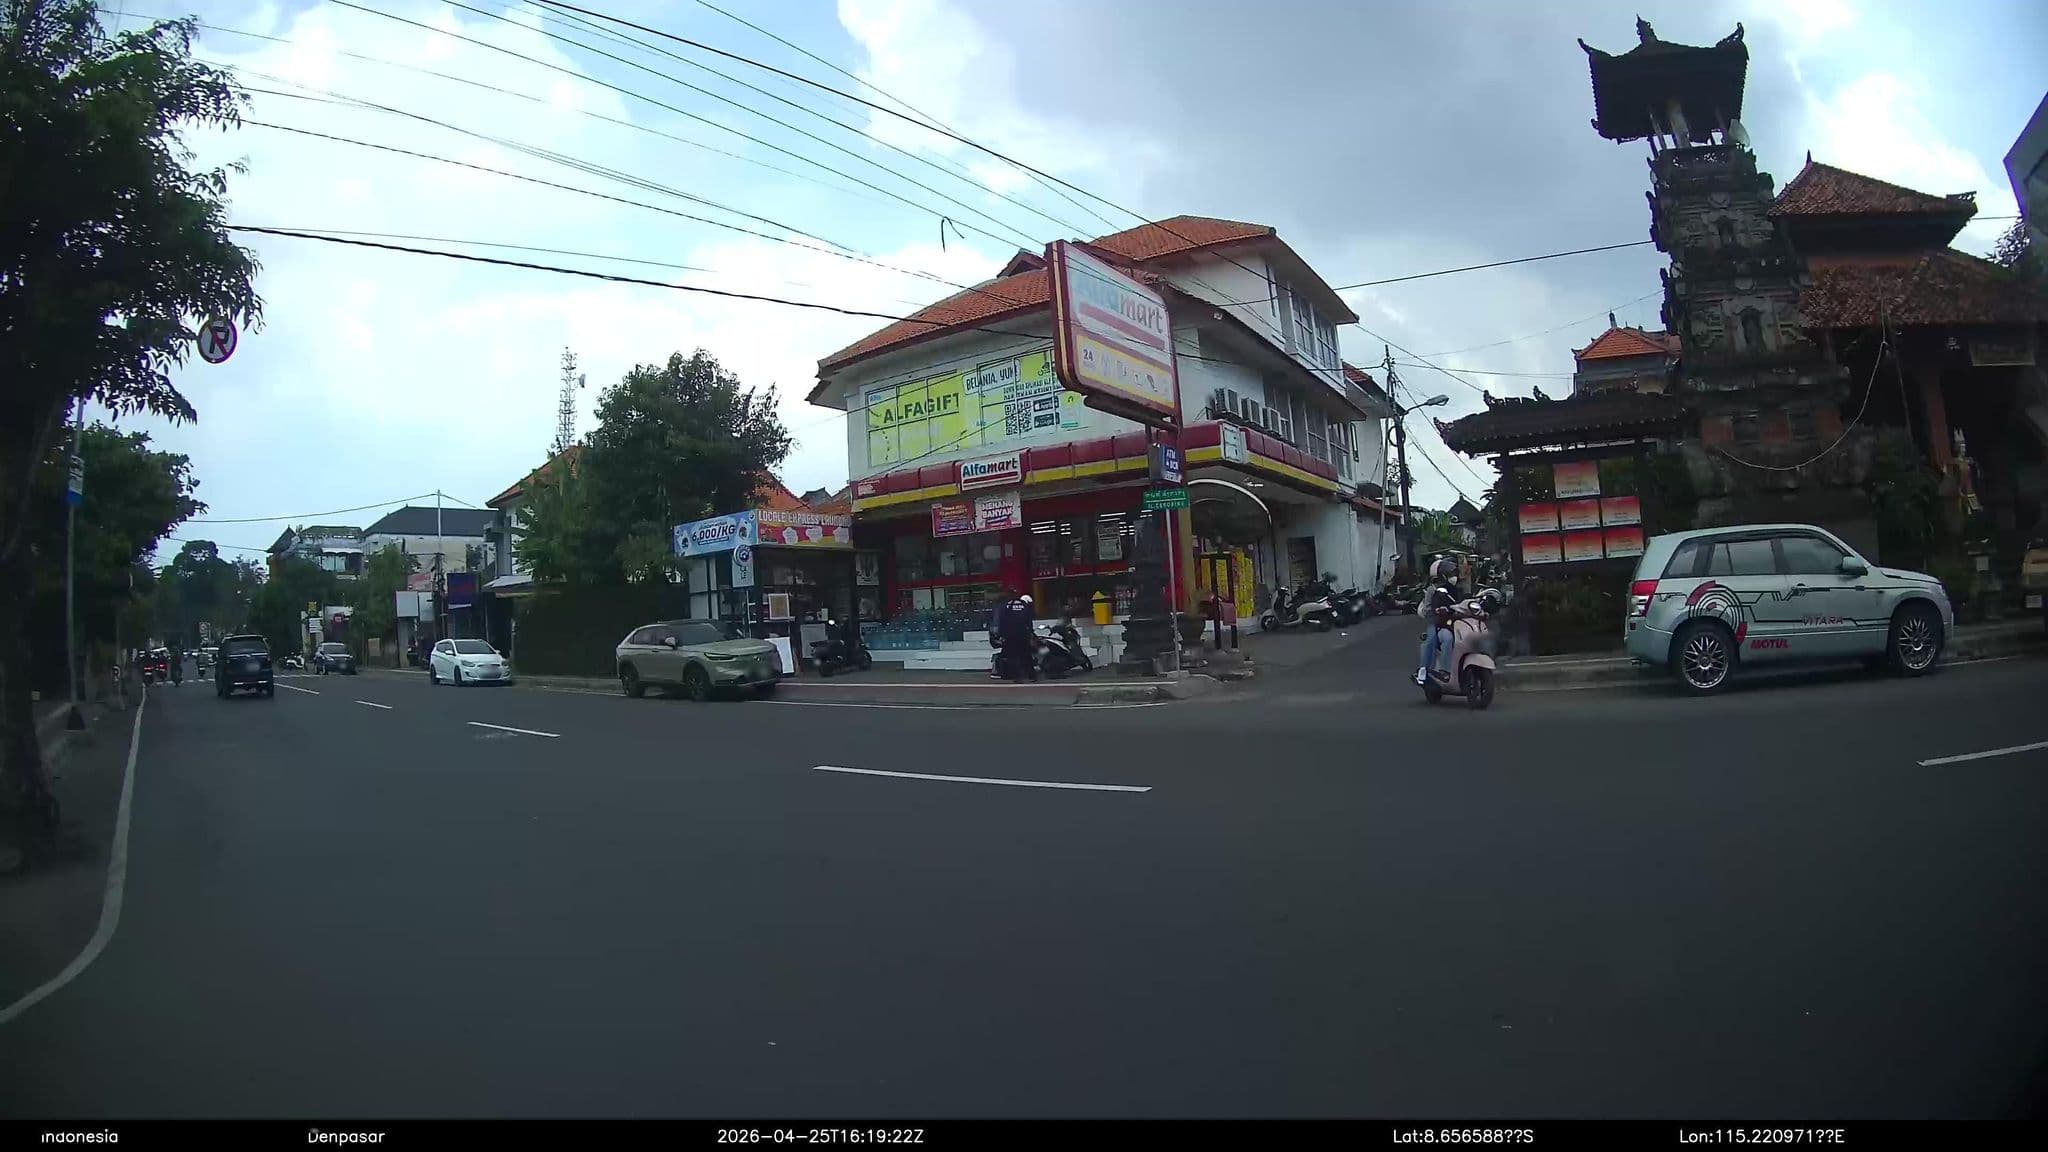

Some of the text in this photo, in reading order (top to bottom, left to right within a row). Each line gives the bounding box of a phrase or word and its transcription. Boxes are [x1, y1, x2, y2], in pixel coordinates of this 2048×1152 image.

[883, 392, 960, 424] ALFAGIFT
[963, 458, 1018, 478] Alfamart
[758, 510, 786, 523] LOCALE
[788, 512, 819, 525] EXPRESS
[982, 507, 1013, 519] BANYAK
[1802, 615, 1844, 626] VITARA
[1750, 640, 1790, 649] MOTUL
